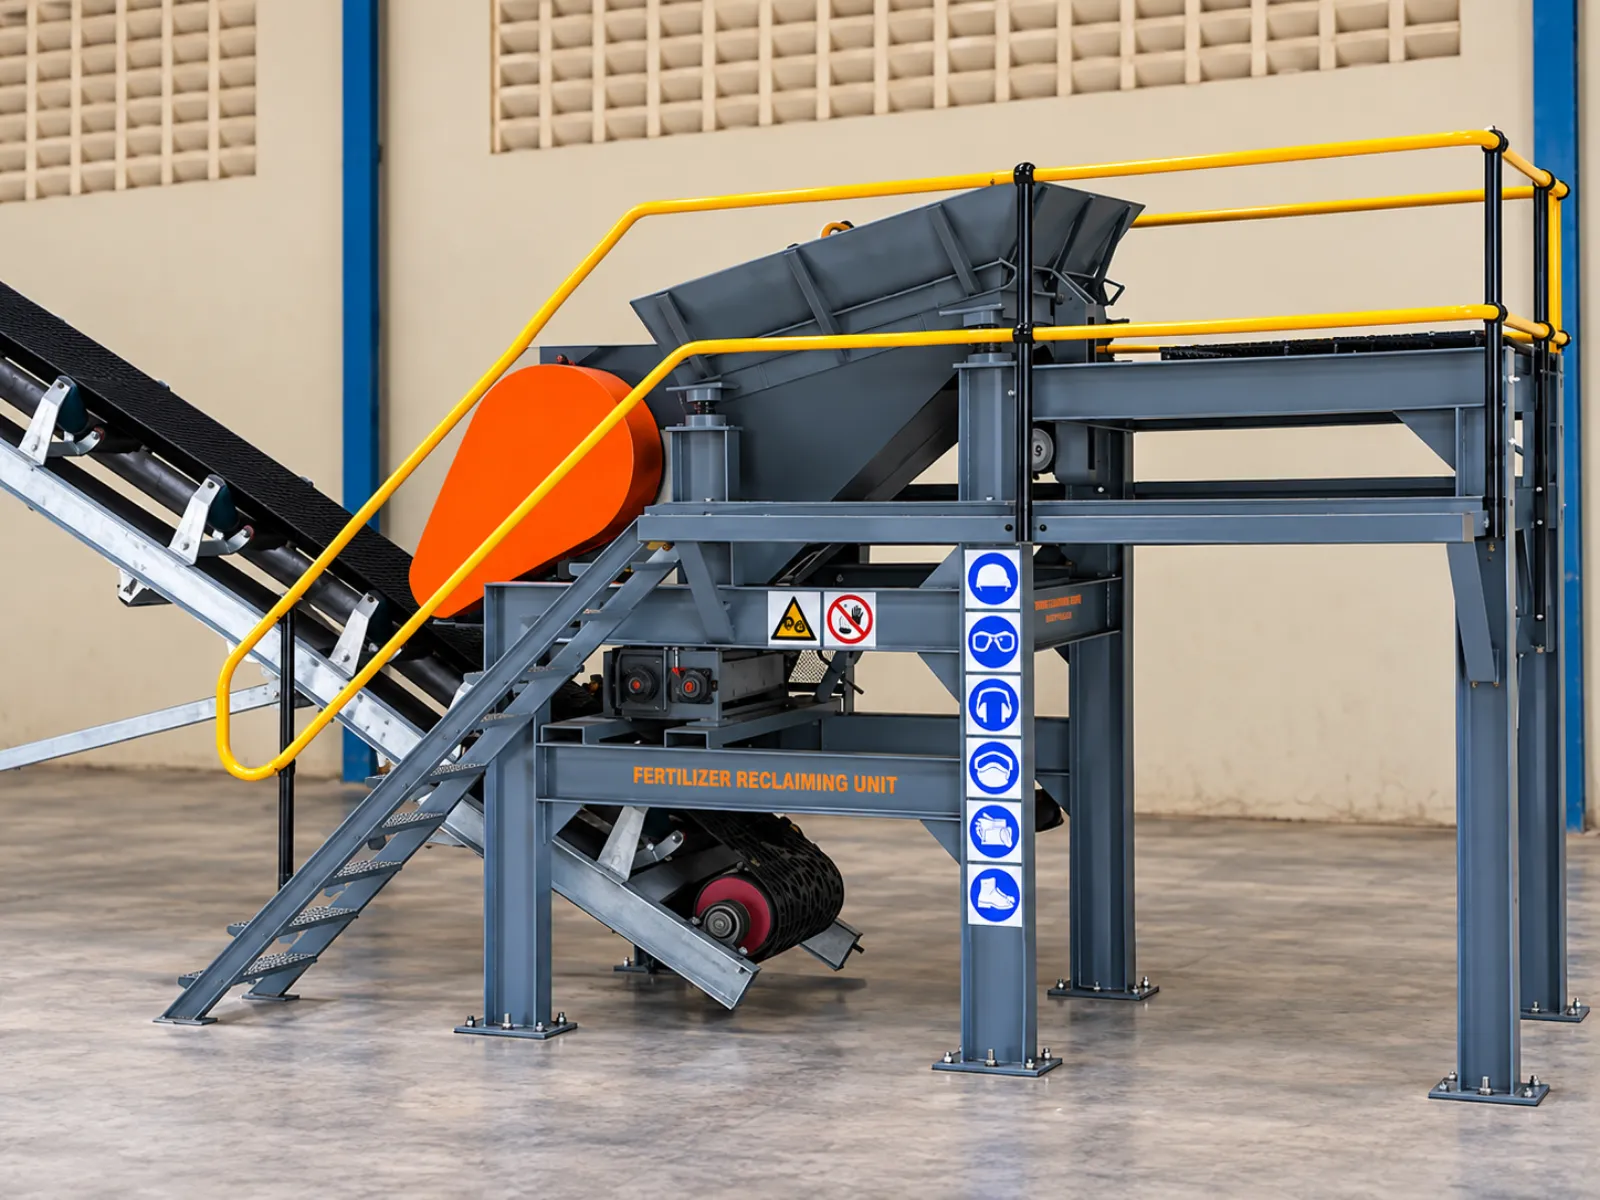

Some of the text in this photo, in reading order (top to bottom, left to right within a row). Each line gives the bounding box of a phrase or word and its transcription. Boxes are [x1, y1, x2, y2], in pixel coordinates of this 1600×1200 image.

[633, 766, 898, 795] FERTILIZER RECLAIMING UNIT
